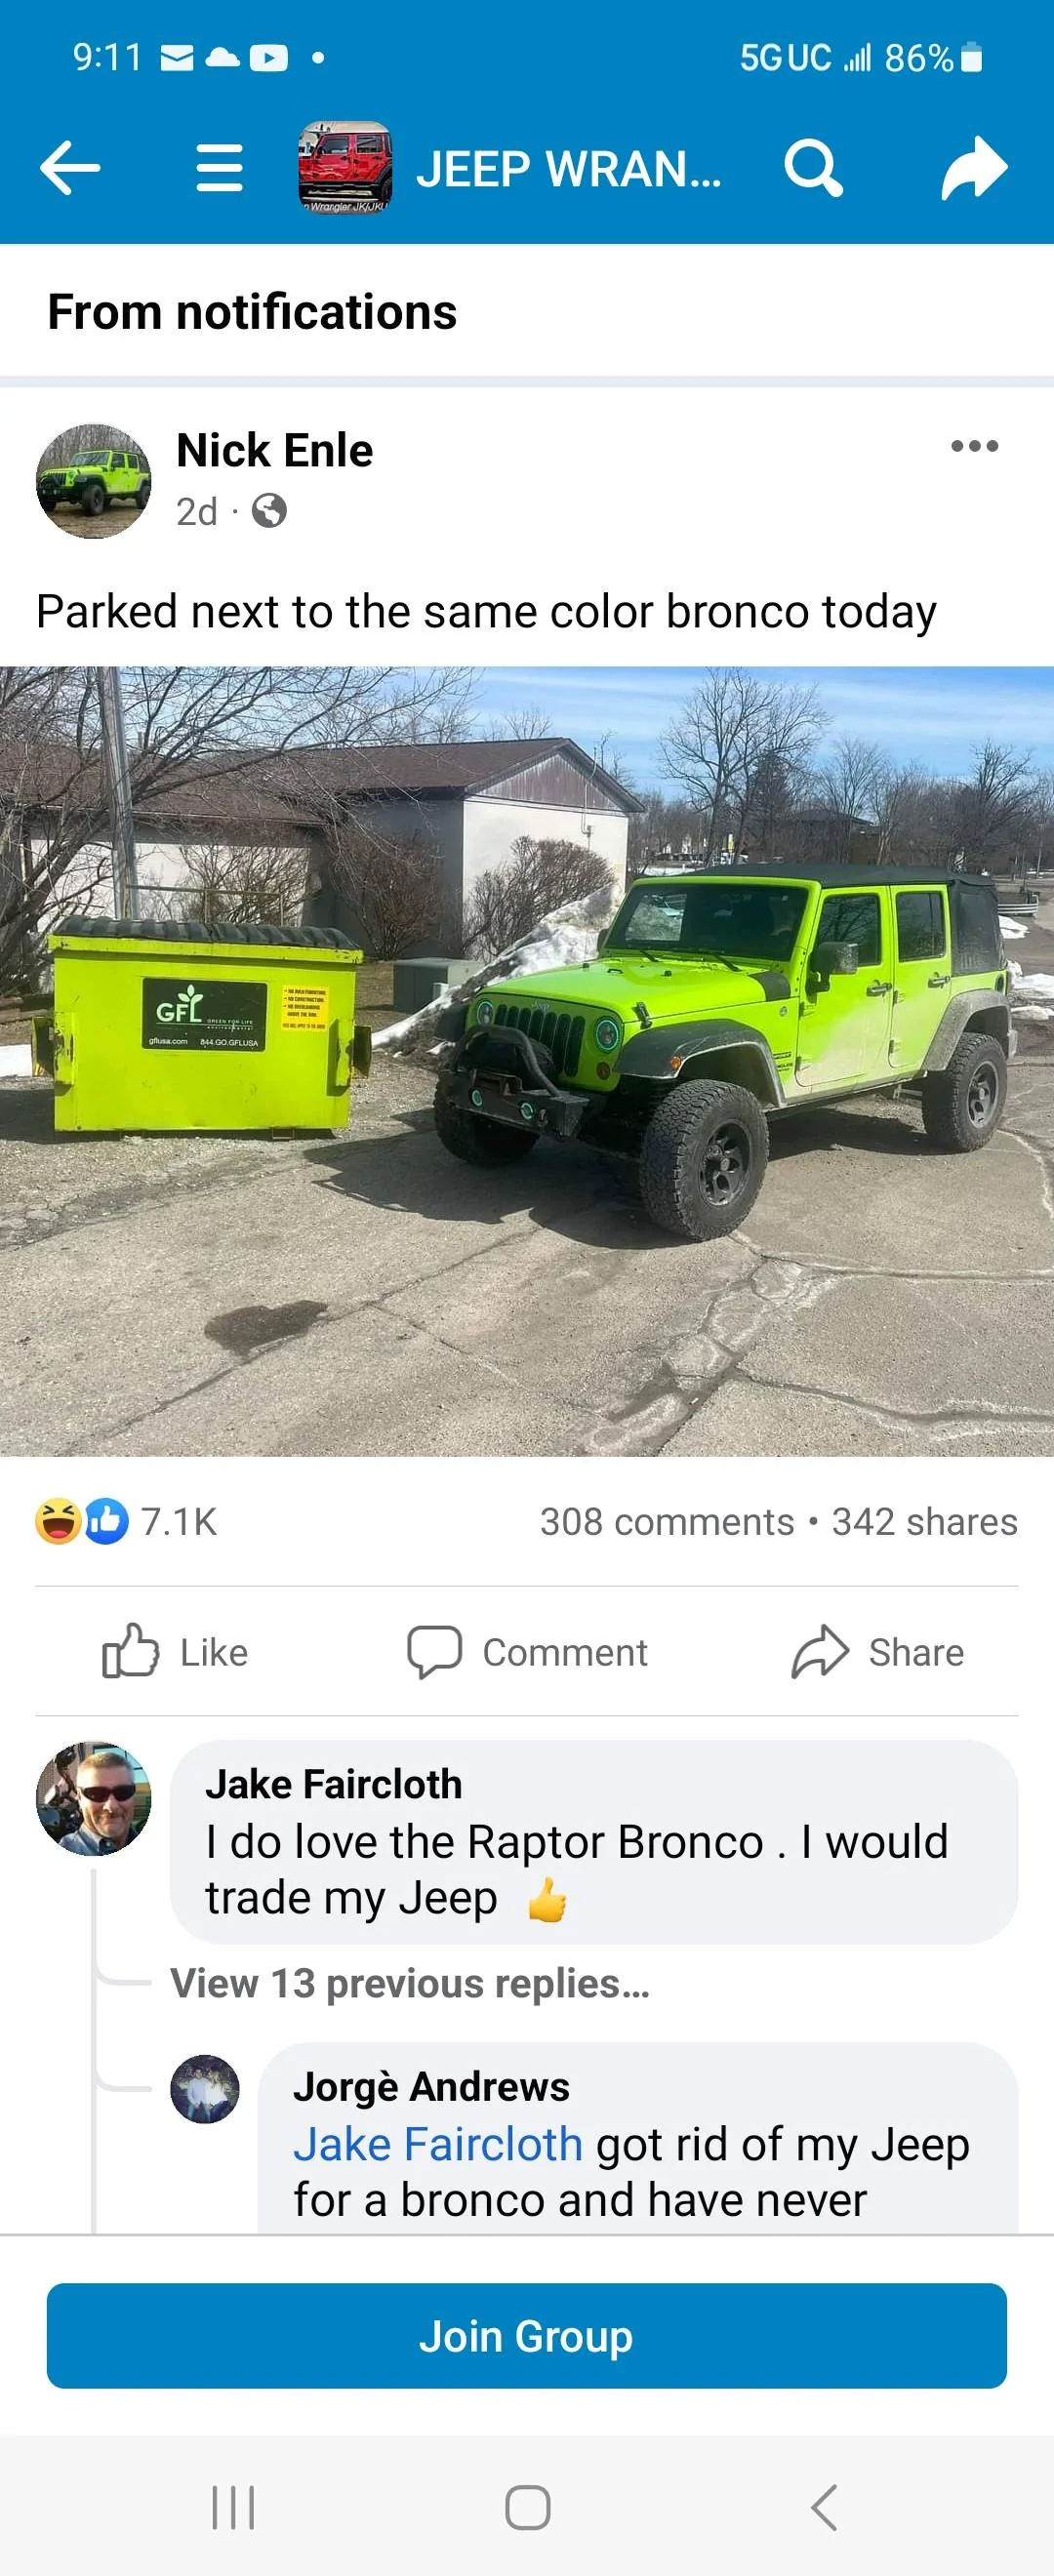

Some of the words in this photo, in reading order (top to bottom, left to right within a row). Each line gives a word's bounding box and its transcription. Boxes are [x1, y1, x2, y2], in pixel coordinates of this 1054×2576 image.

[73, 42, 141, 71] 9:11
[886, 44, 953, 72] 86%
[417, 150, 530, 187] JEEP
[310, 202, 352, 214] Wrangler
[50, 293, 161, 330] From
[178, 291, 457, 330] notifications
[179, 431, 271, 467] Nick
[286, 431, 373, 467] Enle
[178, 496, 217, 526] 2d
[39, 591, 176, 628] Parked
[193, 596, 278, 628] next
[292, 596, 332, 628] to
[345, 592, 410, 628] the
[425, 602, 537, 628] same
[551, 592, 654, 628] color
[669, 592, 808, 628] bronco
[822, 592, 937, 638] today
[156, 1002, 202, 1023] GFL
[148, 1037, 188, 1046] gflusa.com
[200, 1038, 259, 1047] 844.GO.GFLUSA
[142, 1508, 217, 1535] 7.1K
[542, 1508, 602, 1536] 308
[616, 1509, 793, 1536] comments
[833, 1508, 895, 1536] 342
[908, 1507, 1017, 1536] shares
[182, 1636, 248, 1667] Like
[484, 1638, 648, 1667] Comment
[870, 1636, 964, 1667] Share
[206, 1767, 292, 1799] Jake
[304, 1767, 462, 1799] Faircloth
[209, 1825, 214, 1858] I
[231, 1823, 281, 1859] do
[297, 1823, 377, 1859] love
[389, 1823, 454, 1859] the
[470, 1824, 605, 1868] Raptor
[621, 1824, 763, 1859] Bronco
[804, 1824, 809, 1858] I
[826, 1823, 947, 1859] would
[205, 1878, 310, 1914] trade
[326, 1888, 385, 1924] my
[399, 1880, 497, 1923] Jeep
[170, 1967, 259, 1998] View
[272, 1967, 314, 1998] 13
[328, 1967, 483, 2006] previous
[294, 2070, 398, 2110] Jorgè
[409, 2070, 569, 2102] Andrews
[294, 2125, 390, 2161] Jake
[407, 2125, 582, 2161] Faircloth
[597, 2129, 662, 2170] got
[678, 2125, 726, 2161] rid
[743, 2124, 784, 2161] of
[798, 2135, 858, 2170] my
[872, 2127, 969, 2170] Jeep
[294, 2180, 351, 2217] for
[365, 2191, 386, 2217] a
[403, 2181, 545, 2217] bronco
[559, 2181, 632, 2217] and
[650, 2181, 743, 2217] have
[758, 2191, 868, 2217] never
[420, 2319, 502, 2353] Join
[516, 2319, 632, 2361] Group
